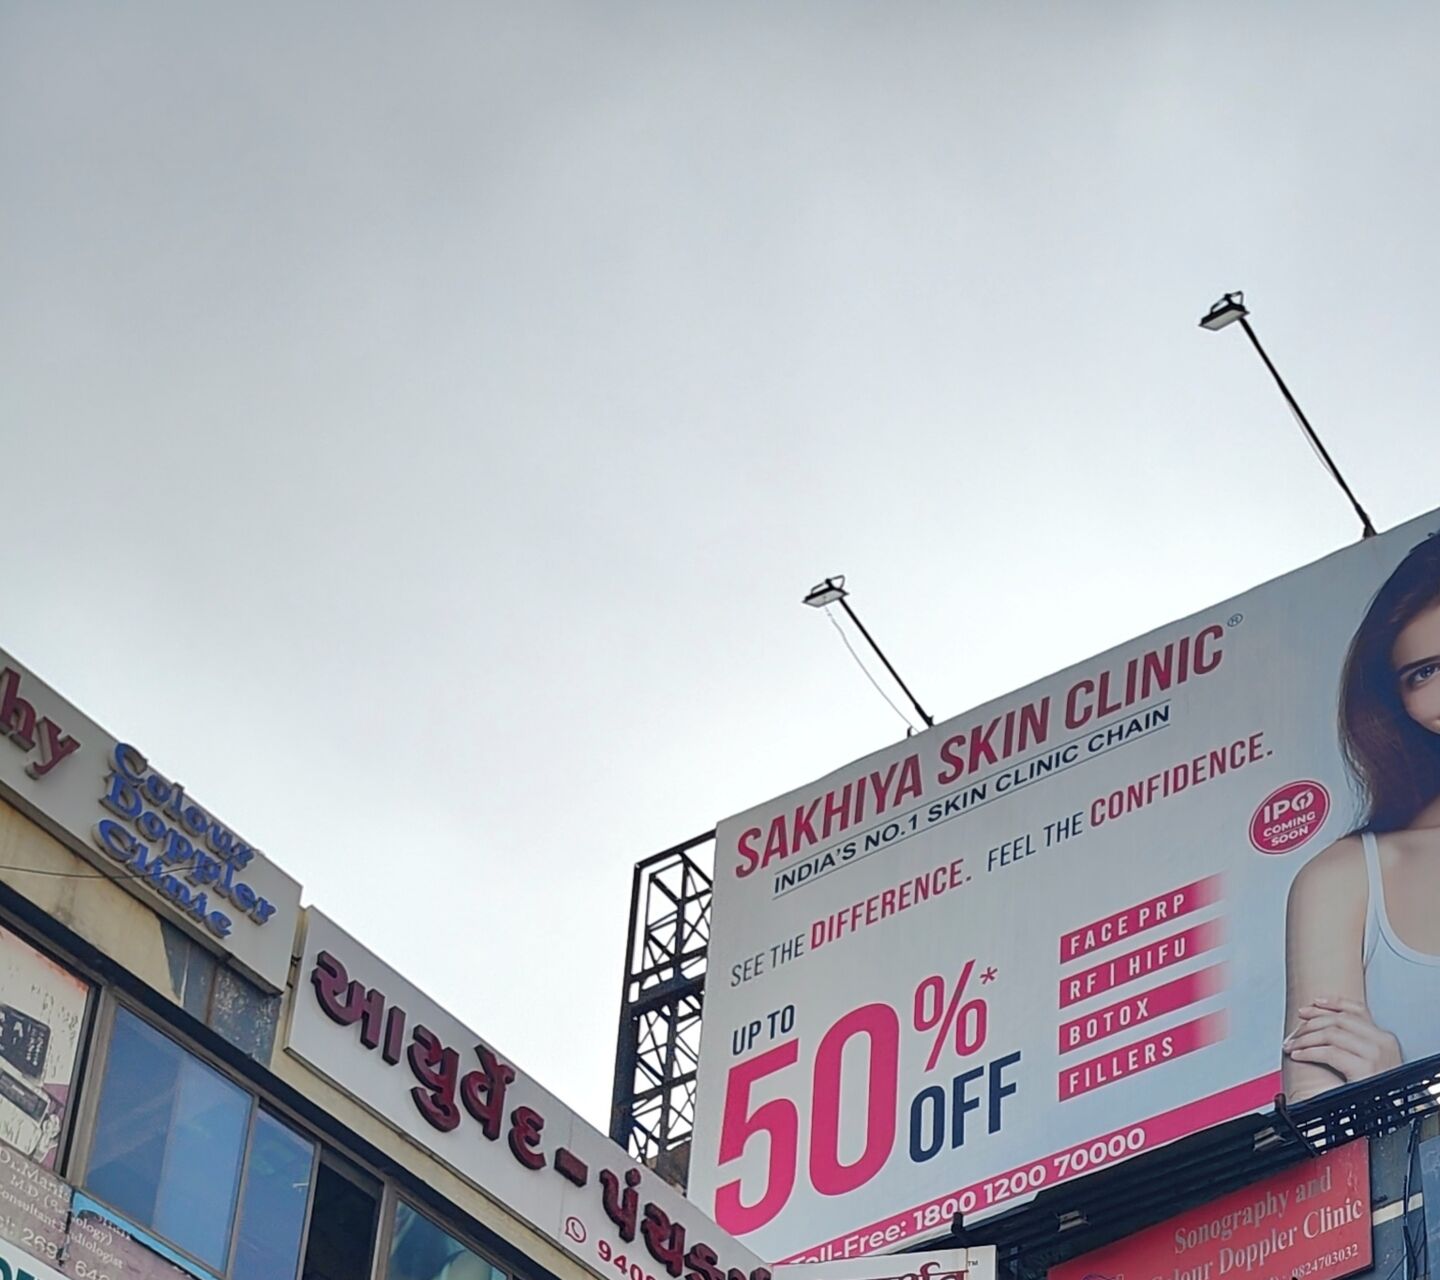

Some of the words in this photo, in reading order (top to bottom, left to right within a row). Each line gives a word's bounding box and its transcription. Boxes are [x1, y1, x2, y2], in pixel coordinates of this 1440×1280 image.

[736, 752, 923, 879] SAKHIYA
[937, 696, 1049, 784] SKIN
[1065, 625, 1223, 731] CLINIC
[865, 814, 919, 851] NO.1
[928, 785, 986, 822] SKIN
[995, 746, 1078, 792] CLINIC
[1087, 705, 1170, 753] CHAIN
[1263, 812, 1315, 837] COMING
[1264, 791, 1314, 824] IPO
[1272, 826, 1308, 846] SOON
[731, 958, 765, 988] SEE
[770, 935, 804, 967] THE
[811, 858, 972, 951] DIFFERENCE.
[988, 833, 1036, 873] FEEL
[1043, 812, 1083, 850] THE
[1091, 732, 1273, 828] CONFIDENCE.
[1070, 922, 1128, 954] FACE
[1139, 894, 1186, 929] PRP
[1070, 973, 1097, 999] RF
[1128, 937, 1187, 974] HIFU
[732, 1022, 761, 1055] UP
[767, 1004, 796, 1039] TO
[1070, 999, 1148, 1046] BOTOX
[1070, 1037, 1173, 1092] FILLERS
[908, 1051, 1021, 1163] OFF
[912, 1190, 976, 1231] 1800
[983, 1163, 1046, 1204] 1200
[1054, 1126, 1146, 1178] 70000
[1174, 1189, 1288, 1254] Sonography
[1295, 1166, 1331, 1202] and
[1219, 1227, 1297, 1275] Doppler
[1303, 1199, 1362, 1239] Clinic
[1291, 1244, 1358, 1280] 9824703032
